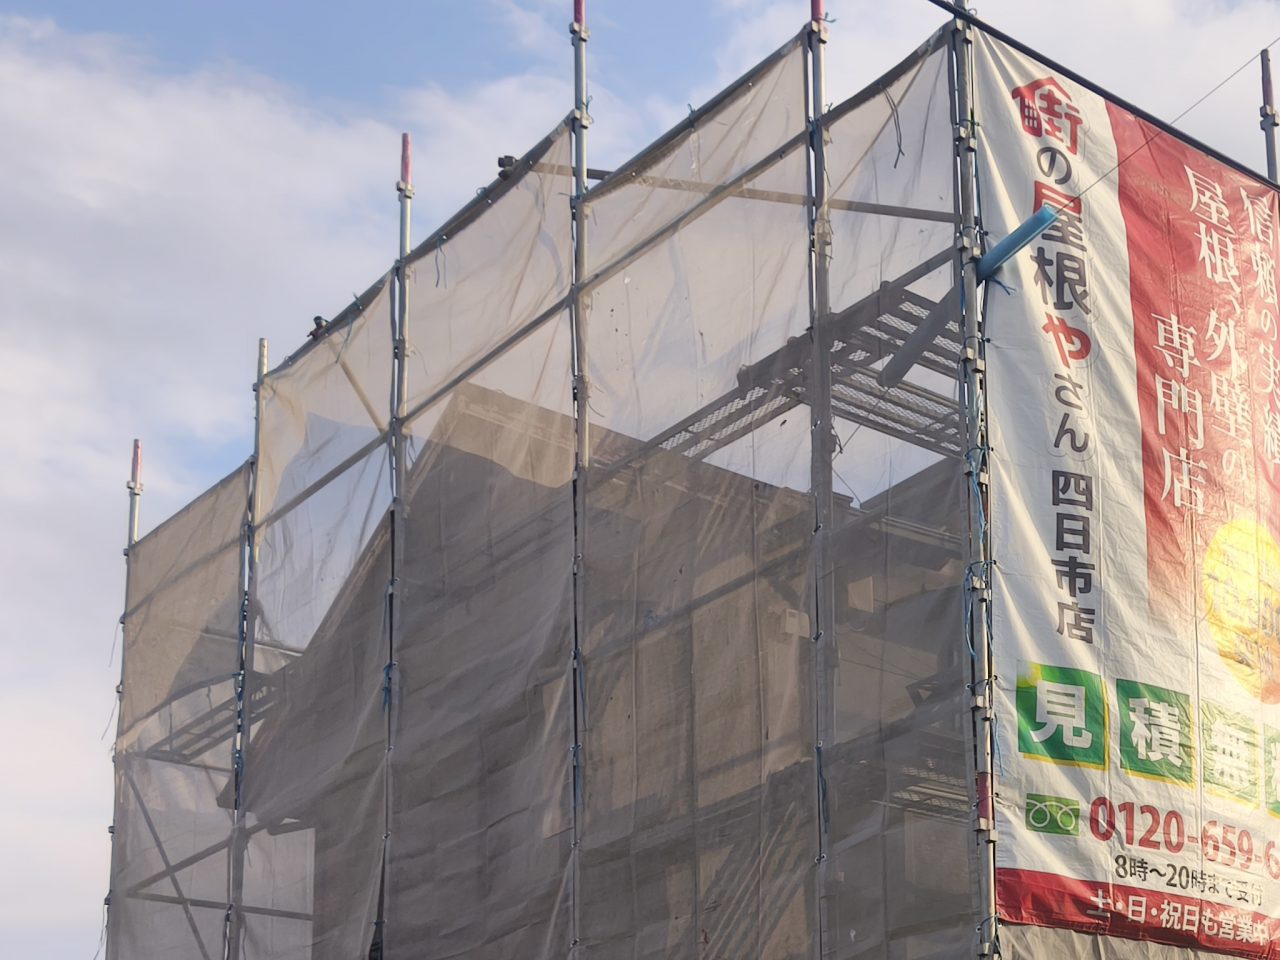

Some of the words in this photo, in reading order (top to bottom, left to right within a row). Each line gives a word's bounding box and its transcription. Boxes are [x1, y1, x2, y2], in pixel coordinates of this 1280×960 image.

[1011, 76, 1093, 453] 街の屋根やさん
[1151, 313, 1208, 515] 専門店
[1051, 470, 1096, 645] 四日市店
